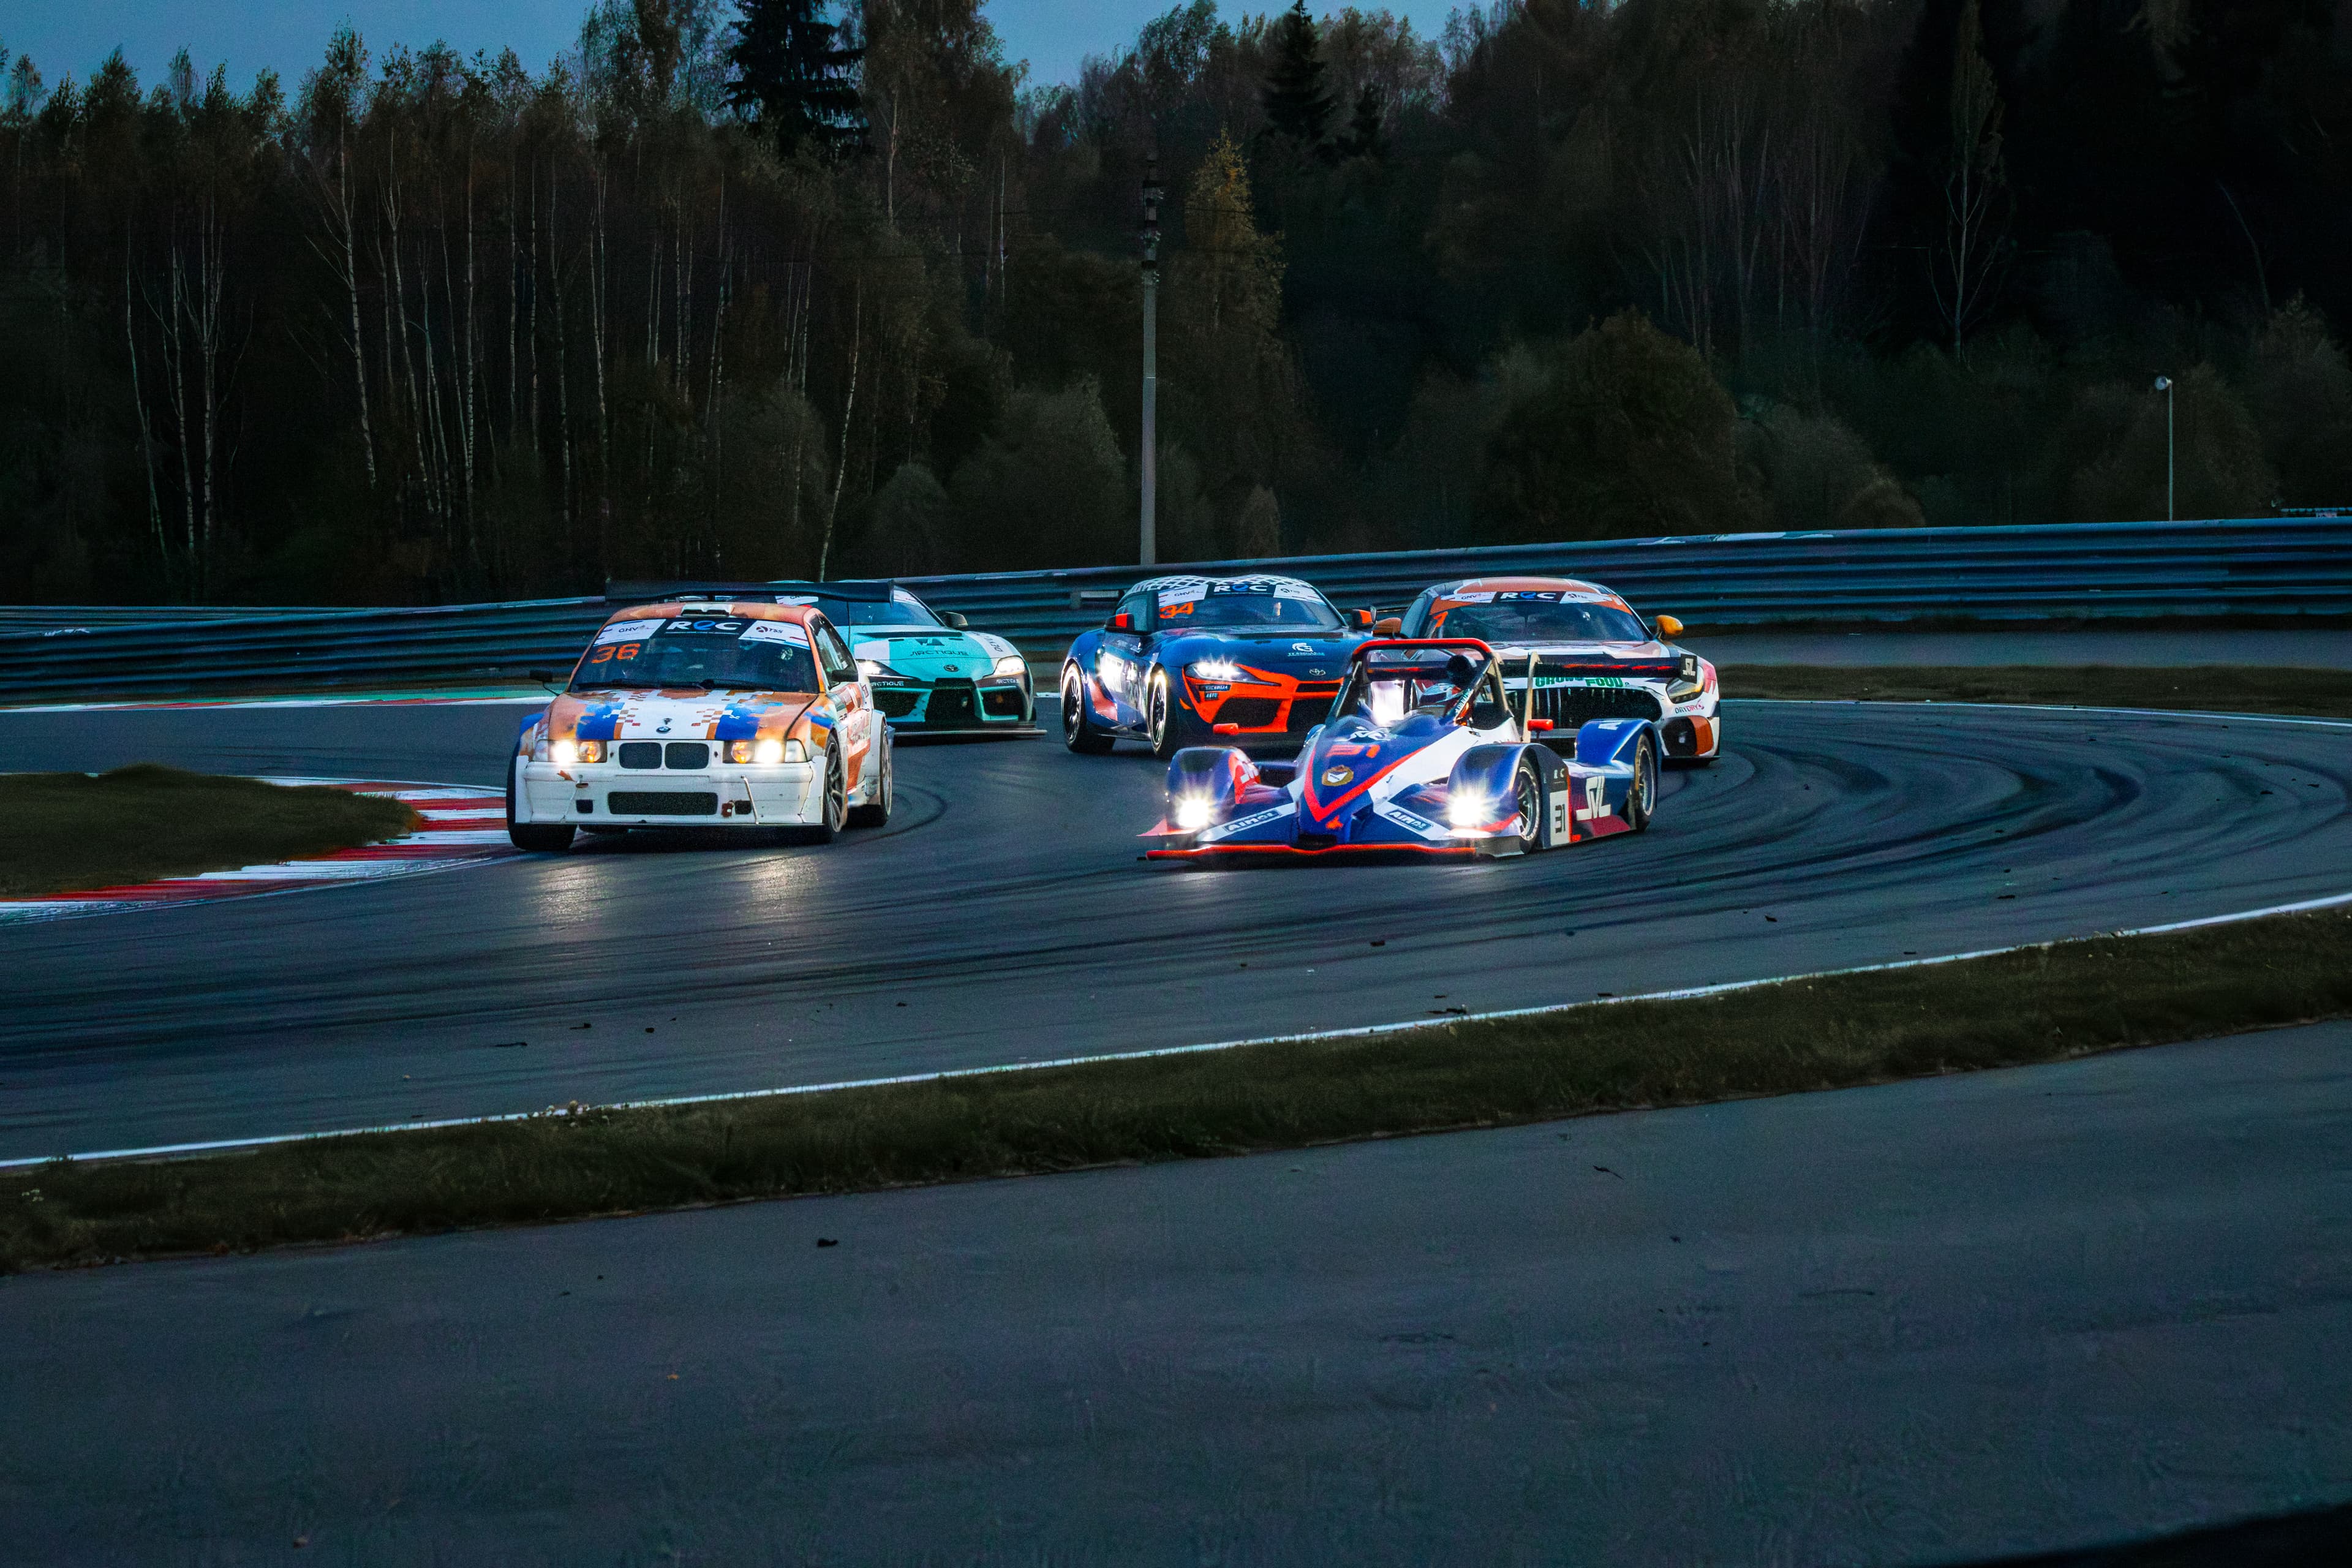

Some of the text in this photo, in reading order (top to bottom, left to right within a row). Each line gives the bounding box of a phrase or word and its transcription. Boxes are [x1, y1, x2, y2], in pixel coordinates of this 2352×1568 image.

[1159, 601, 1194, 619] 34
[591, 643, 641, 663] 36
[1556, 804, 1566, 834] 31
